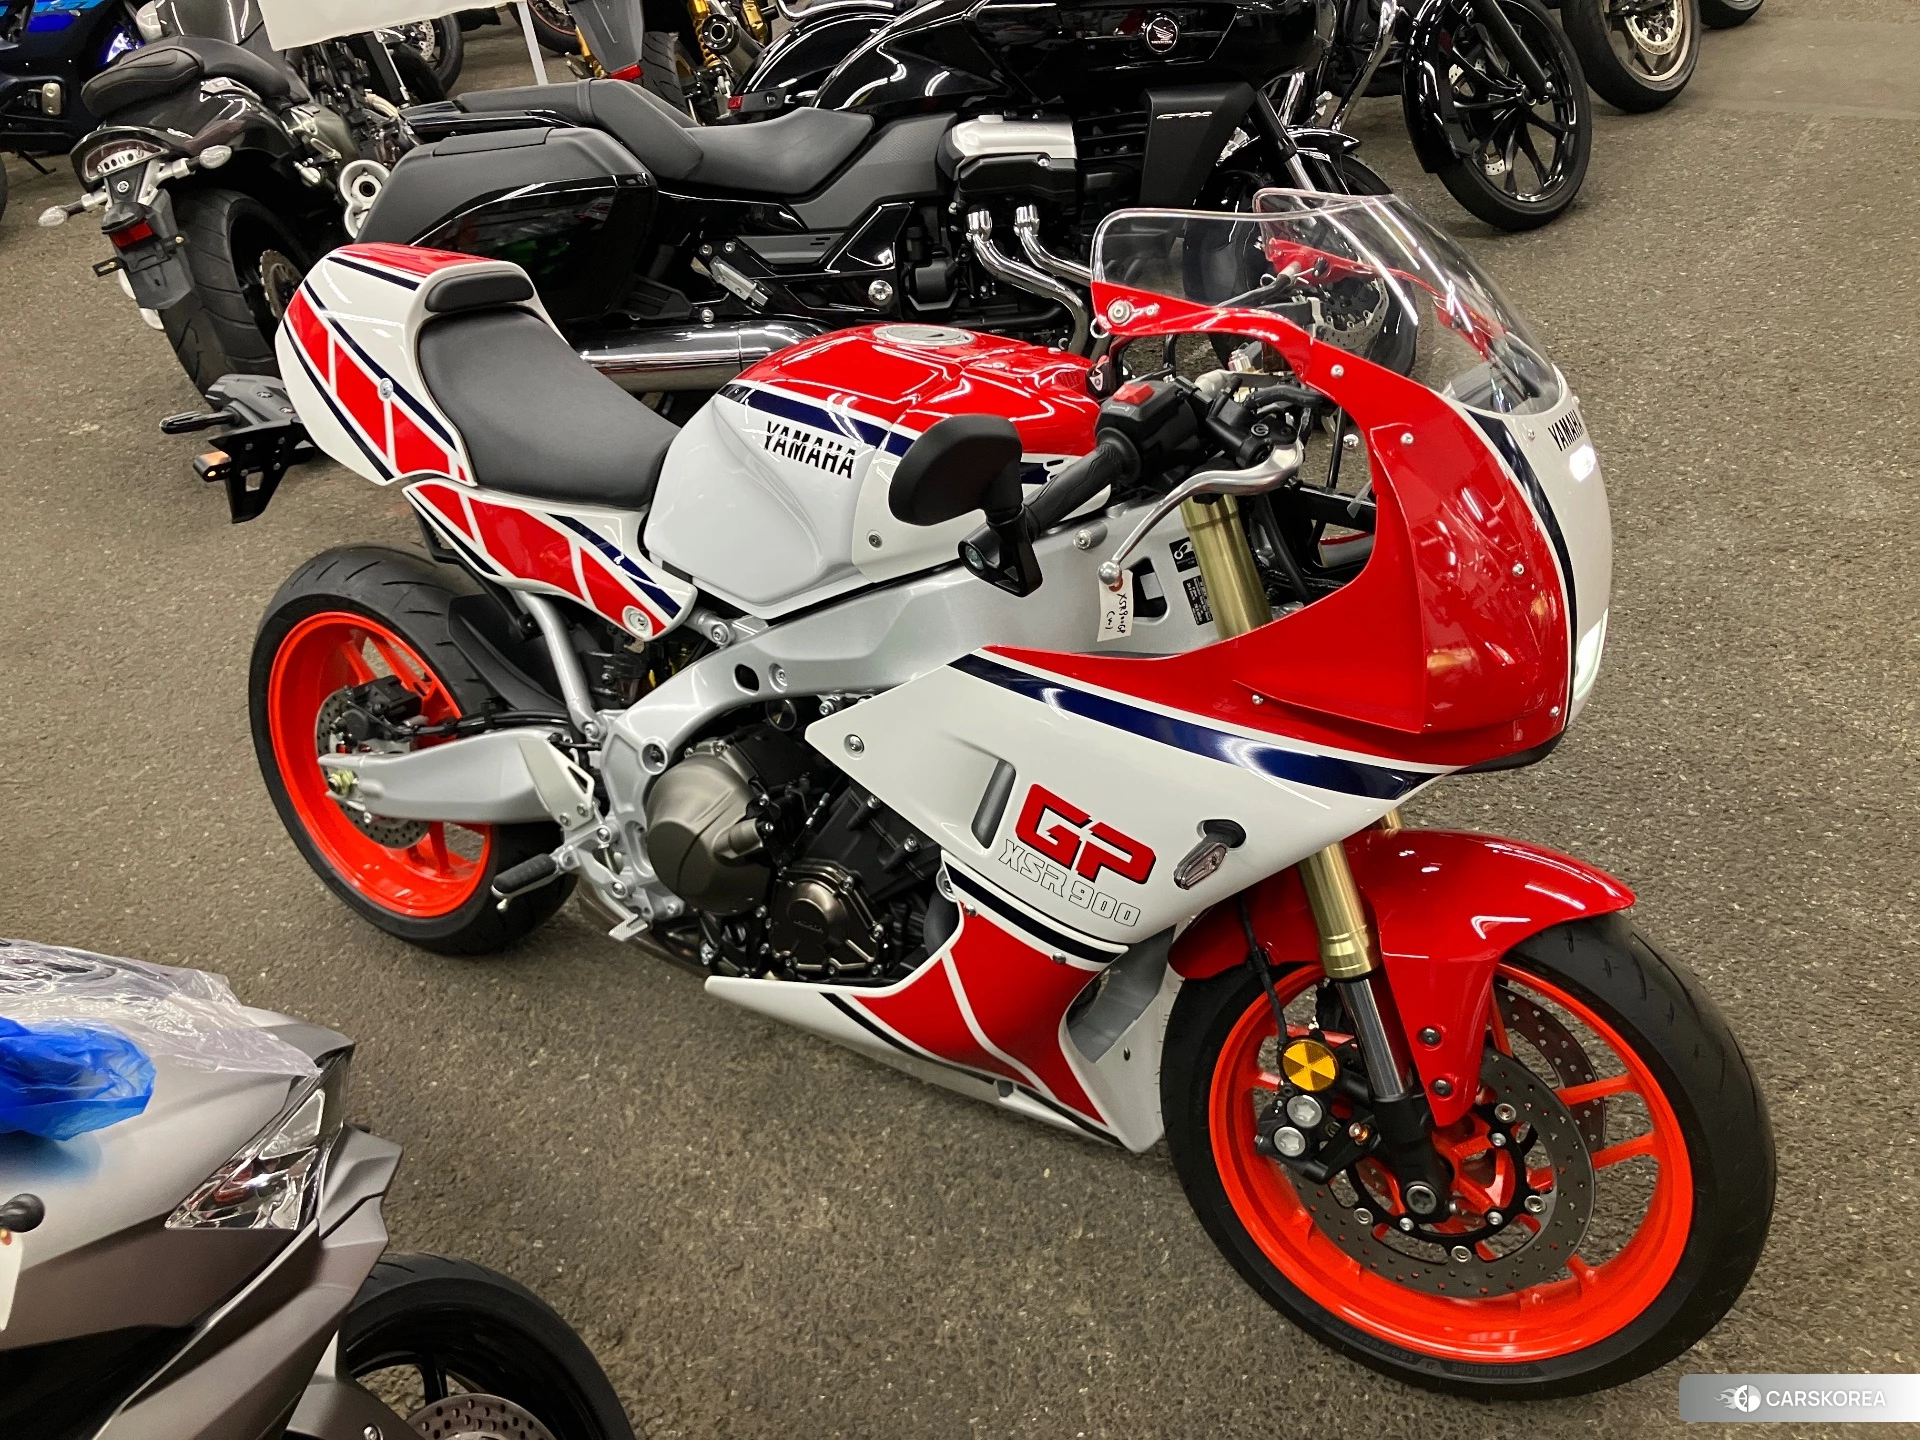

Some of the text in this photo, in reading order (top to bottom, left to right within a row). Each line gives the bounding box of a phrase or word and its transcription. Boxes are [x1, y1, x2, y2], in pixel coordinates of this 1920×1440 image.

[764, 420, 856, 479] YAMAHA
[1547, 408, 1584, 452] YAMAHA
[1015, 783, 1157, 885] GP
